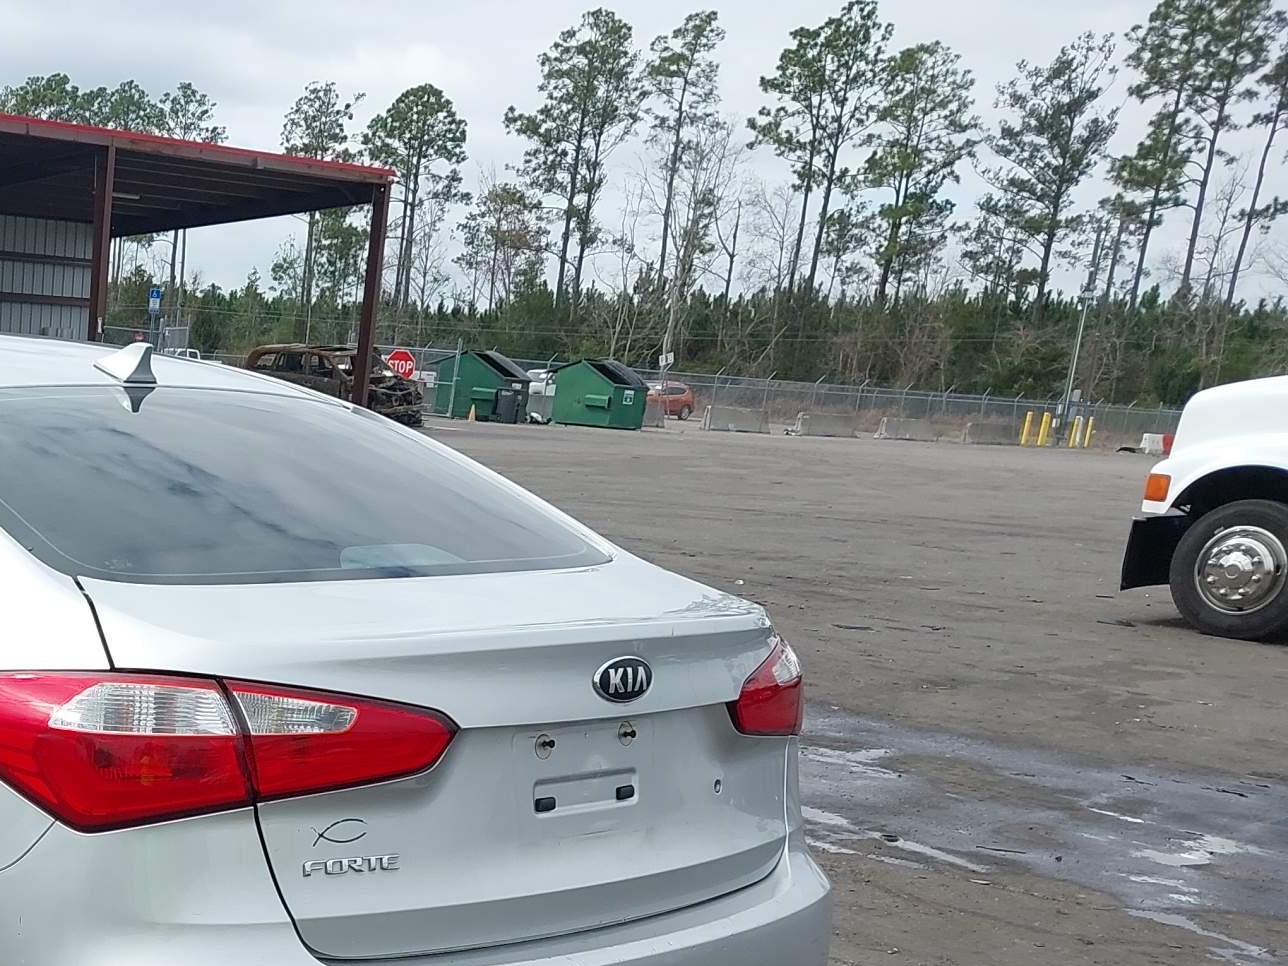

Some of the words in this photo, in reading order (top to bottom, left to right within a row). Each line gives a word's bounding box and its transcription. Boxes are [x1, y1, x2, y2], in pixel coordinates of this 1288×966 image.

[388, 359, 413, 373] STOP
[607, 666, 648, 694] KIA
[302, 853, 400, 877] FORTE
